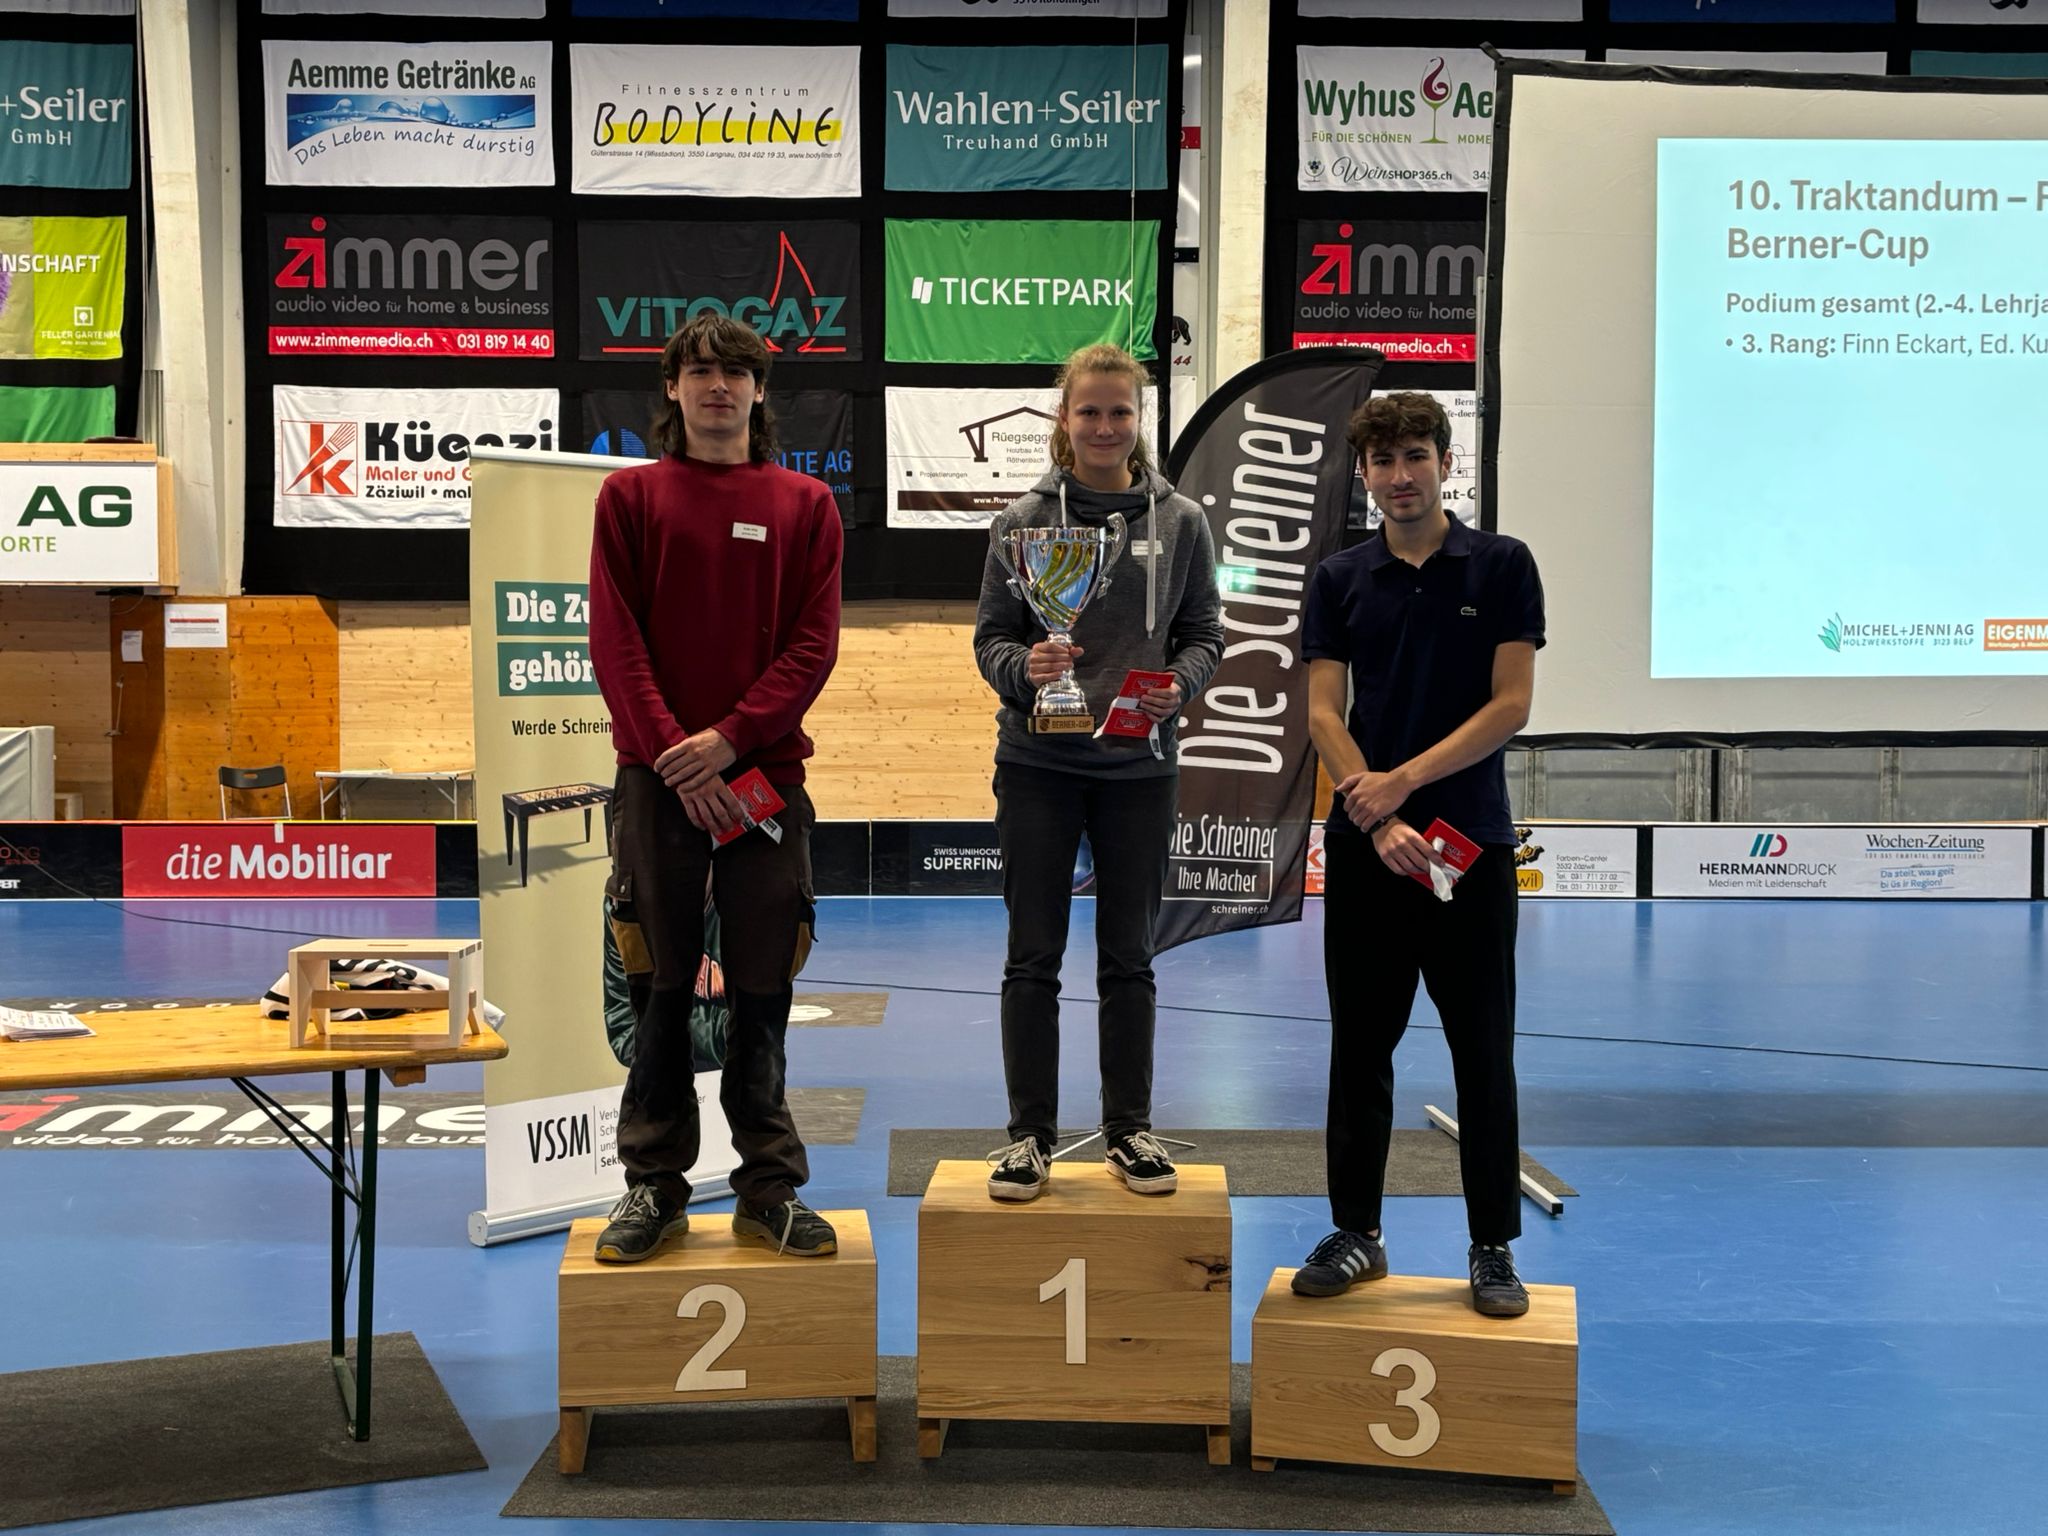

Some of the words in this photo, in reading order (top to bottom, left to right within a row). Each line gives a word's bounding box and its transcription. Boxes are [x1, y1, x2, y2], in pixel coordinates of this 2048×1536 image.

[288, 58, 388, 88] Aemme
[397, 59, 515, 89] Getränke
[519, 76, 536, 89] AG
[622, 84, 809, 97] Fitnesszentrum
[893, 90, 1160, 125] Wahlen+Seiler
[1304, 79, 1415, 126] Wyhus
[11, 128, 72, 146] GmbH
[294, 141, 327, 165] Das
[332, 126, 385, 147] Leben
[394, 128, 455, 146] macht
[463, 134, 535, 156] durstig
[943, 134, 1038, 150] Treuhand
[1050, 133, 1108, 149] GmbH
[1337, 133, 1354, 143] DIE
[1358, 131, 1412, 143] SCHÖNEN
[1729, 180, 1781, 210] 10.
[1791, 180, 1998, 211] Traktandum
[274, 216, 549, 291] zimmer
[1728, 228, 1929, 267] Berner-Cup
[2, 254, 101, 273] NSCHAFT
[939, 277, 1134, 306] TICKETPARK
[276, 294, 326, 313] audio
[332, 295, 381, 313] video
[386, 300, 401, 313] für
[407, 295, 455, 314] home
[461, 303, 470, 314] &
[475, 296, 549, 315] business
[1301, 301, 1350, 320] audio
[1356, 302, 1402, 320] video
[1408, 306, 1423, 320] für
[1429, 302, 1476, 320] home
[1726, 293, 1816, 313] Podium
[1822, 295, 1909, 318] gesamt
[1915, 293, 1974, 318] (2.-4.
[276, 332, 433, 349] www.zimmermedia.ch
[457, 333, 480, 350] 031
[485, 334, 508, 350] 819
[513, 334, 527, 350] 14
[531, 334, 550, 350] 40
[1742, 334, 1763, 354] 3.
[1770, 334, 1836, 358] Rang:
[1843, 334, 1889, 354] Finn
[1896, 334, 1973, 357] Eckart,
[1980, 334, 2014, 354] Ed.
[824, 450, 851, 473] AG
[365, 466, 417, 481] Maler
[424, 467, 455, 481] und
[920, 471, 968, 479] Projektierungen
[365, 485, 425, 499] Zäziwil
[443, 486, 471, 499] mal
[17, 485, 132, 527] AG
[1, 536, 57, 552] ORTE
[506, 590, 556, 623] Die
[1843, 624, 1951, 636] MICHEL+JENNI
[1954, 624, 1974, 636] AG
[1843, 638, 1924, 646] HOLZWERKSTOFFE
[509, 651, 593, 691] gehör
[512, 719, 556, 735] Werde
[562, 718, 612, 734] Schrein
[1176, 685, 1287, 774] Die
[1197, 814, 1278, 858] Schreiner
[1866, 834, 1985, 852] Wochen-Zeitung
[166, 844, 222, 880] die
[229, 844, 392, 880] Mobiliar
[934, 848, 957, 856] SWISS
[1178, 866, 1201, 890] Ihre
[1205, 867, 1257, 892] Macher
[1700, 863, 1837, 875] HERRMANNDRUCK
[1881, 870, 1893, 878] Da
[1708, 879, 1744, 888] Medien
[1746, 878, 1762, 888] mit
[1765, 879, 1827, 888] Leidenschaft
[1211, 904, 1269, 914] schreiner.ch
[12, 1133, 143, 1145] video
[157, 1136, 201, 1145] für
[527, 1113, 591, 1163] VSSM
[1038, 1258, 1087, 1365] 1
[674, 1284, 747, 1392] 2
[1368, 1347, 1441, 1457] 3
